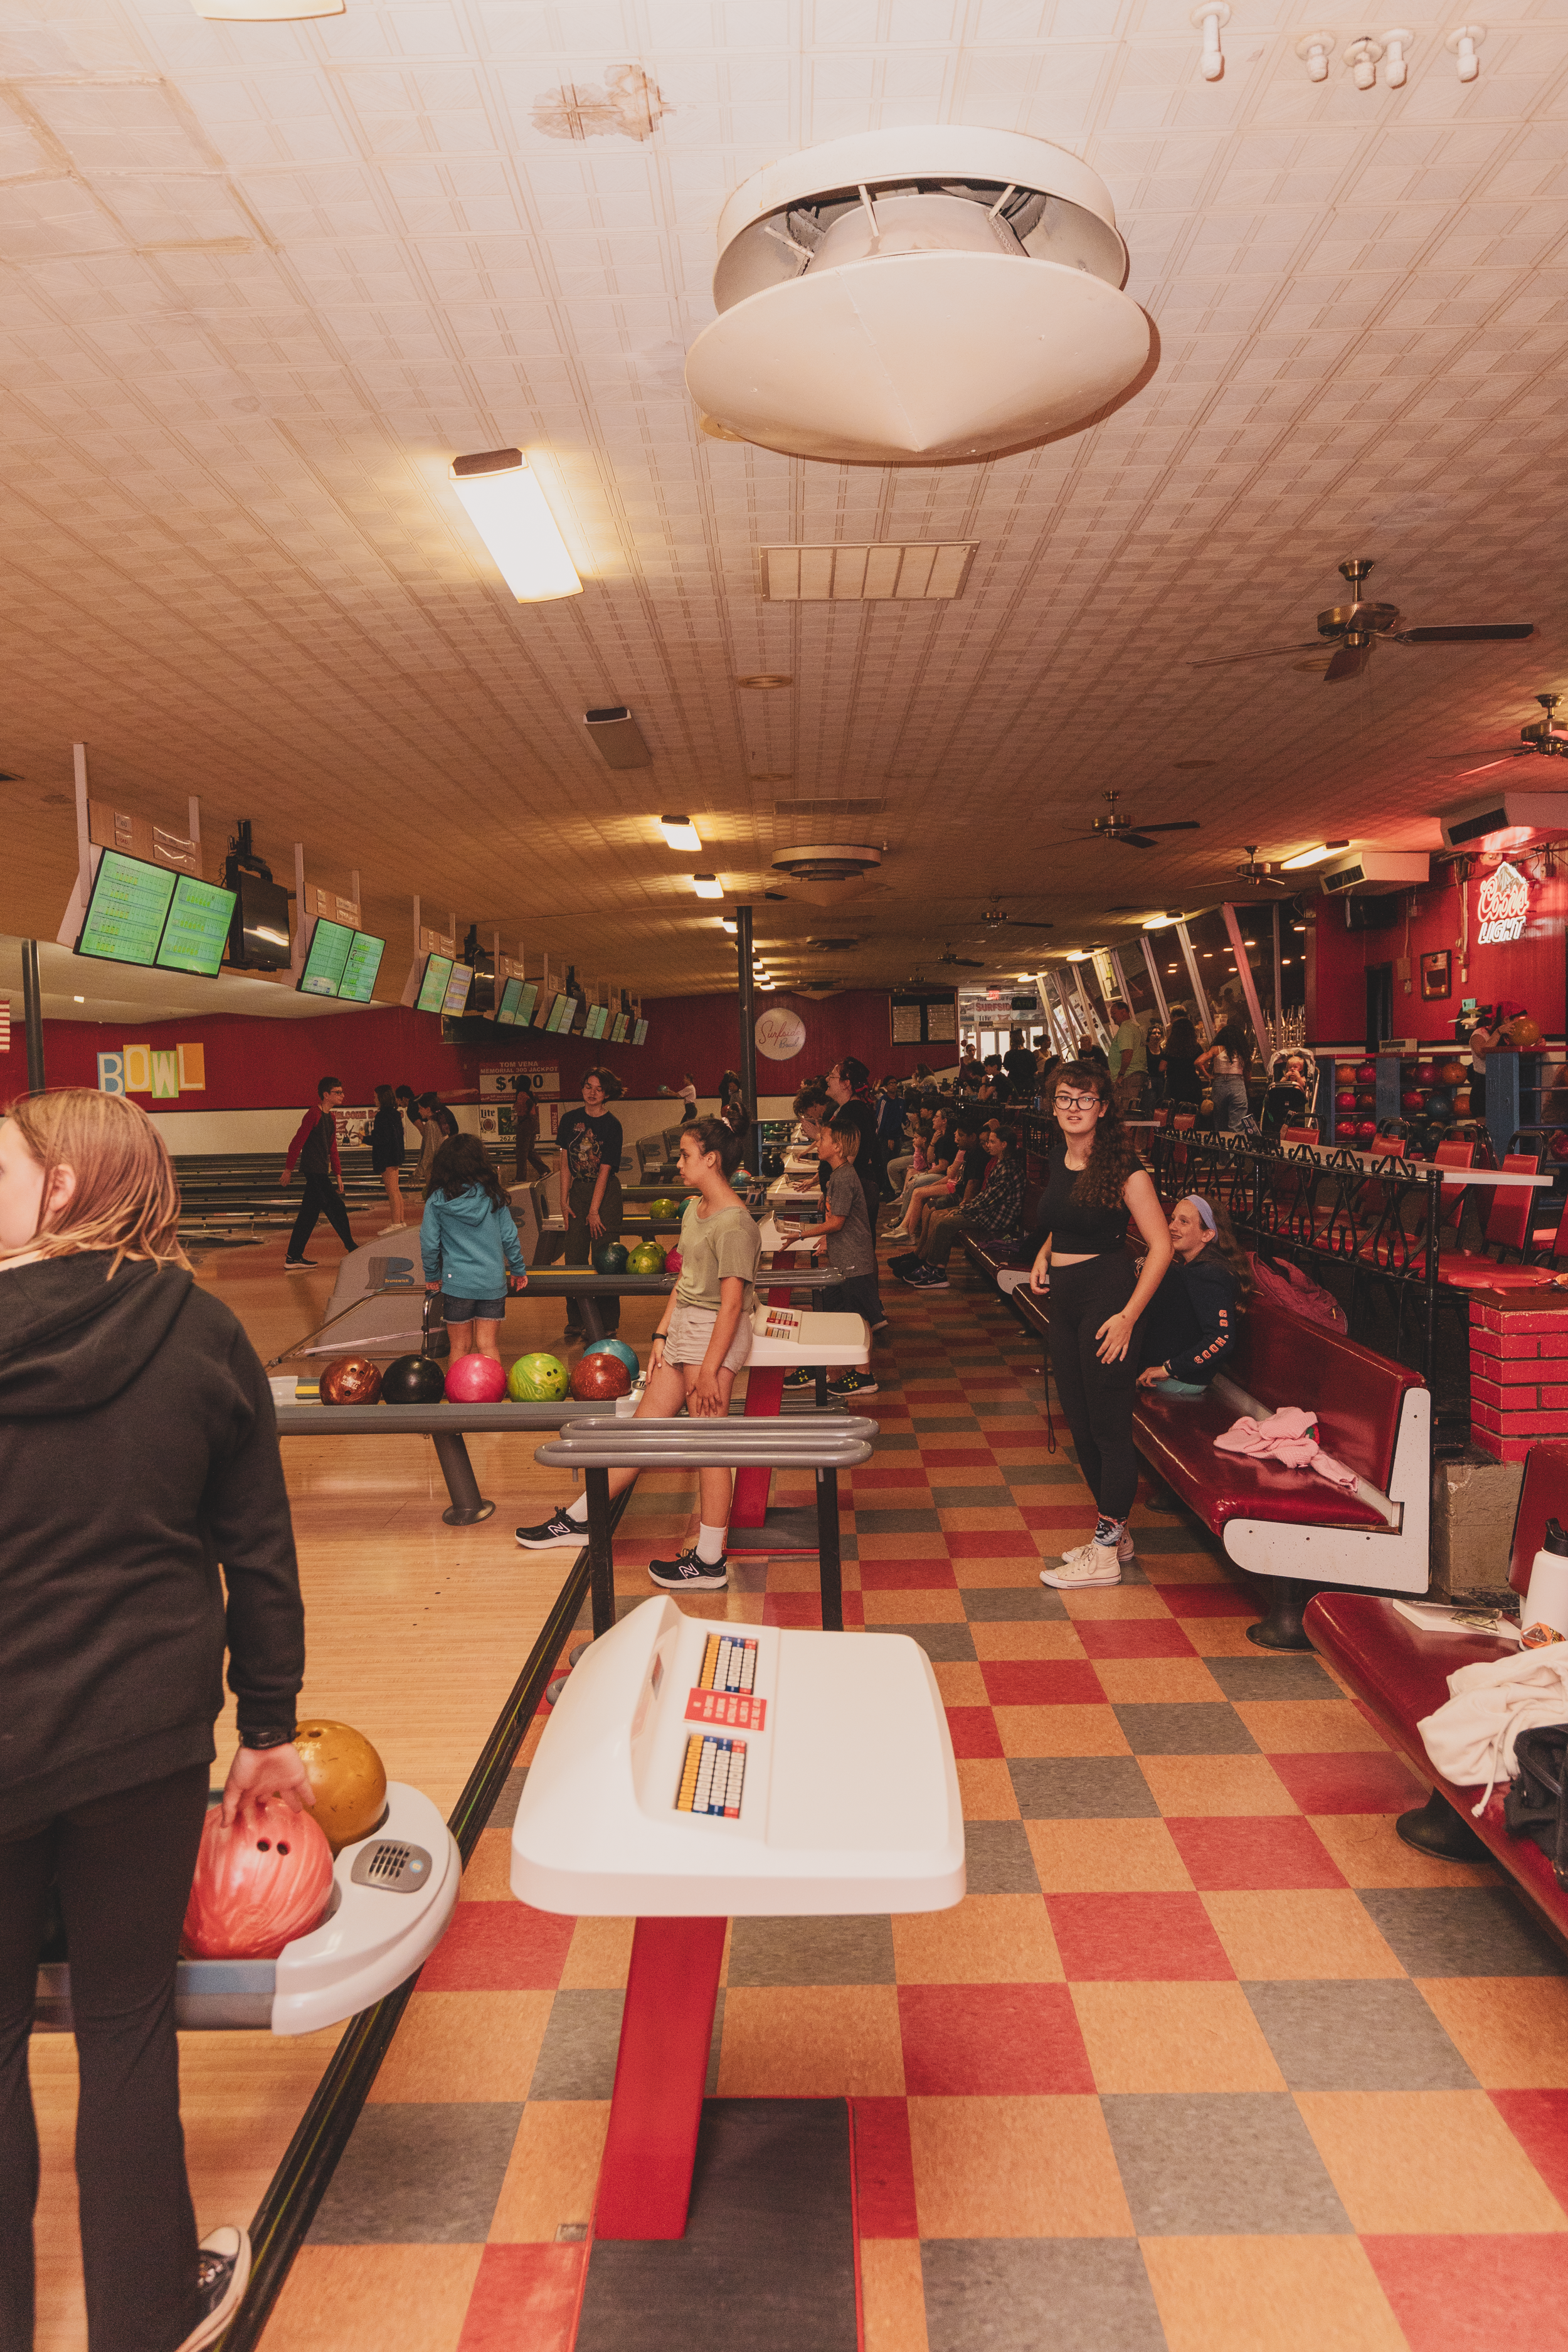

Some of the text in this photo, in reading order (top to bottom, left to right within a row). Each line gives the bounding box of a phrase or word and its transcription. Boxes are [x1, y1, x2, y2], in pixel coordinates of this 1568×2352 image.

[1478, 876, 1529, 923] Coors
[1478, 916, 1526, 945] LIGHT
[975, 1003, 1012, 1012] SURFSID
[98, 1045, 203, 1096] BOWL
[495, 1074, 543, 1092] $10
[480, 1109, 495, 1118] Lite
[1219, 1309, 1229, 1327] GO
